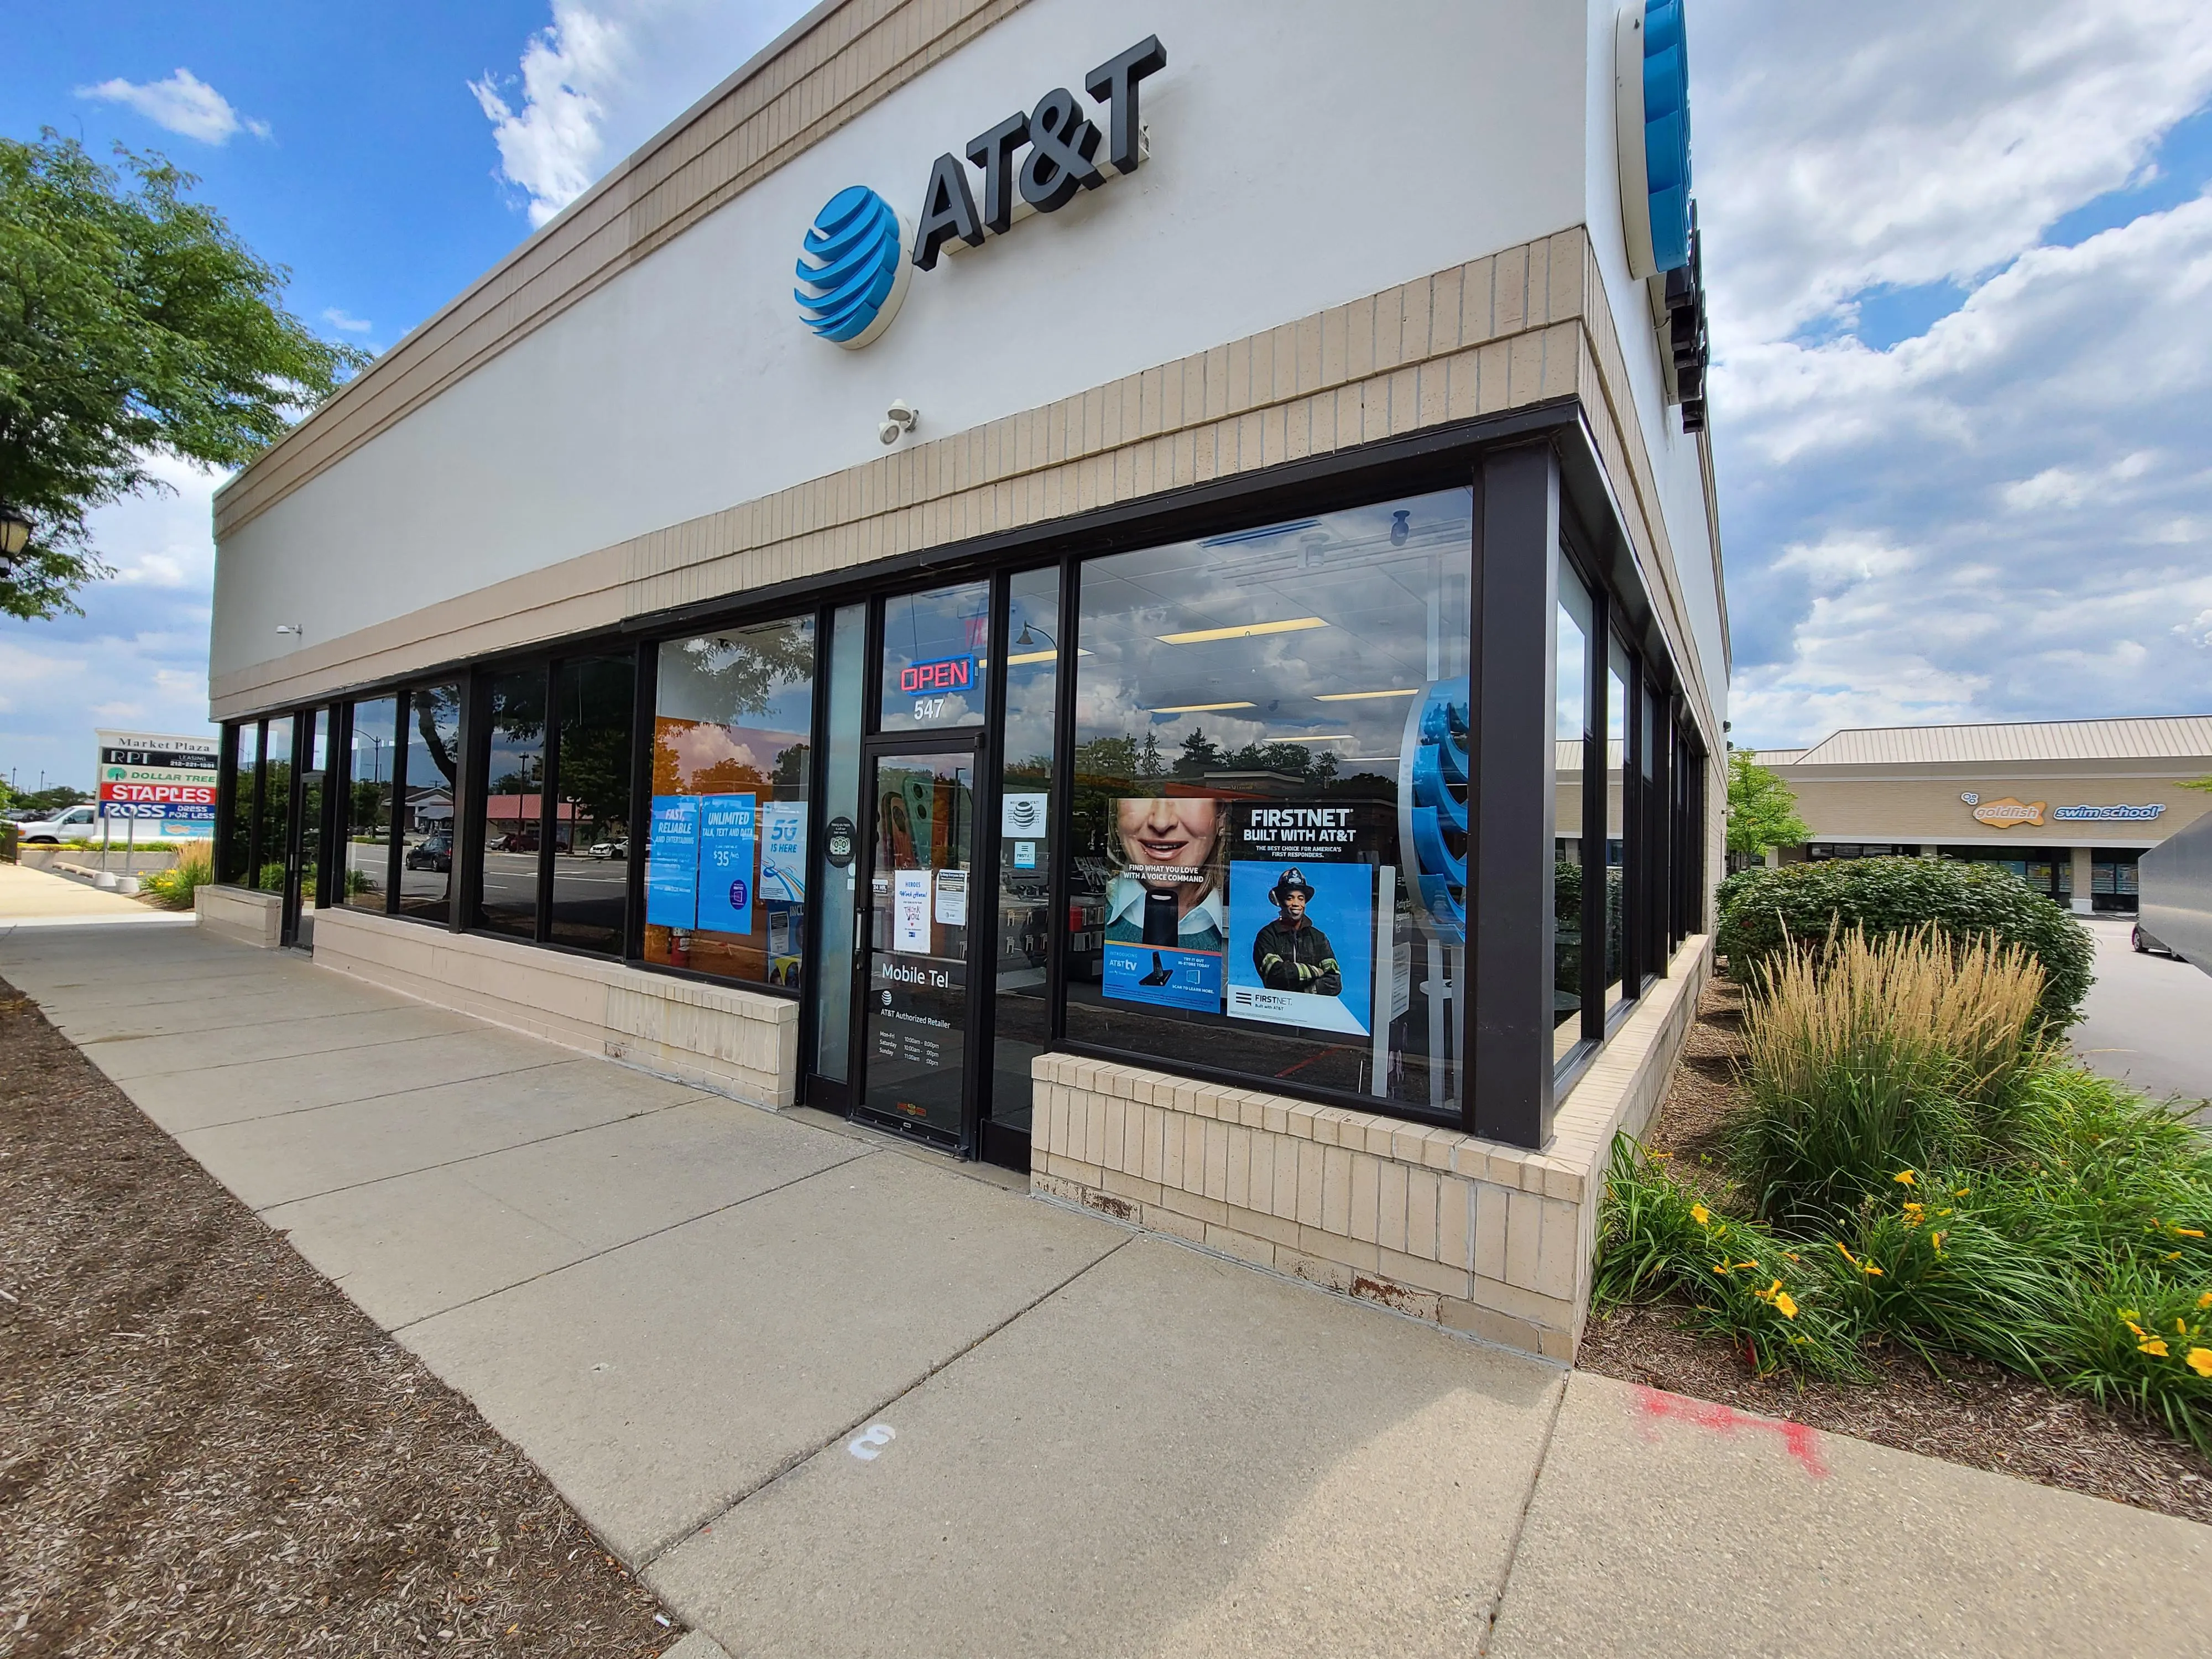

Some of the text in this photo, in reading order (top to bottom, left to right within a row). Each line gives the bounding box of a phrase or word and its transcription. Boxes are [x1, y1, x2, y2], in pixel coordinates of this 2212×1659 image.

[912, 34, 1167, 272] AT&T
[900, 661, 968, 691] OPEN
[914, 698, 944, 720] 547
[118, 738, 210, 752] Market Plaza
[111, 750, 152, 764] RPT
[131, 771, 215, 783] DOLLAR TREE
[112, 785, 211, 803] STAPLES
[105, 803, 166, 817] ROSS
[665, 809, 685, 822] FAST,
[1976, 806, 2039, 819] goldfish
[2054, 805, 2157, 818] swim school
[708, 812, 749, 825] UNLIMITED
[1251, 808, 1350, 827] FIRSTNET
[658, 822, 692, 834] RELIABLE
[702, 828, 753, 838] TALK, TEXT AND DATA
[771, 820, 798, 841] 5G
[1244, 829, 1357, 842] BUILT WITH AT&T
[770, 843, 797, 853] IS HERE
[1168, 874, 1204, 883] COMMAND
[1125, 959, 1137, 971] tv
[882, 963, 949, 988] Mobile Tel
[881, 1009, 951, 1029] AT&T Authorized Retailer
[880, 1039, 897, 1049] Saturday
[879, 1047, 894, 1056] Sunday
